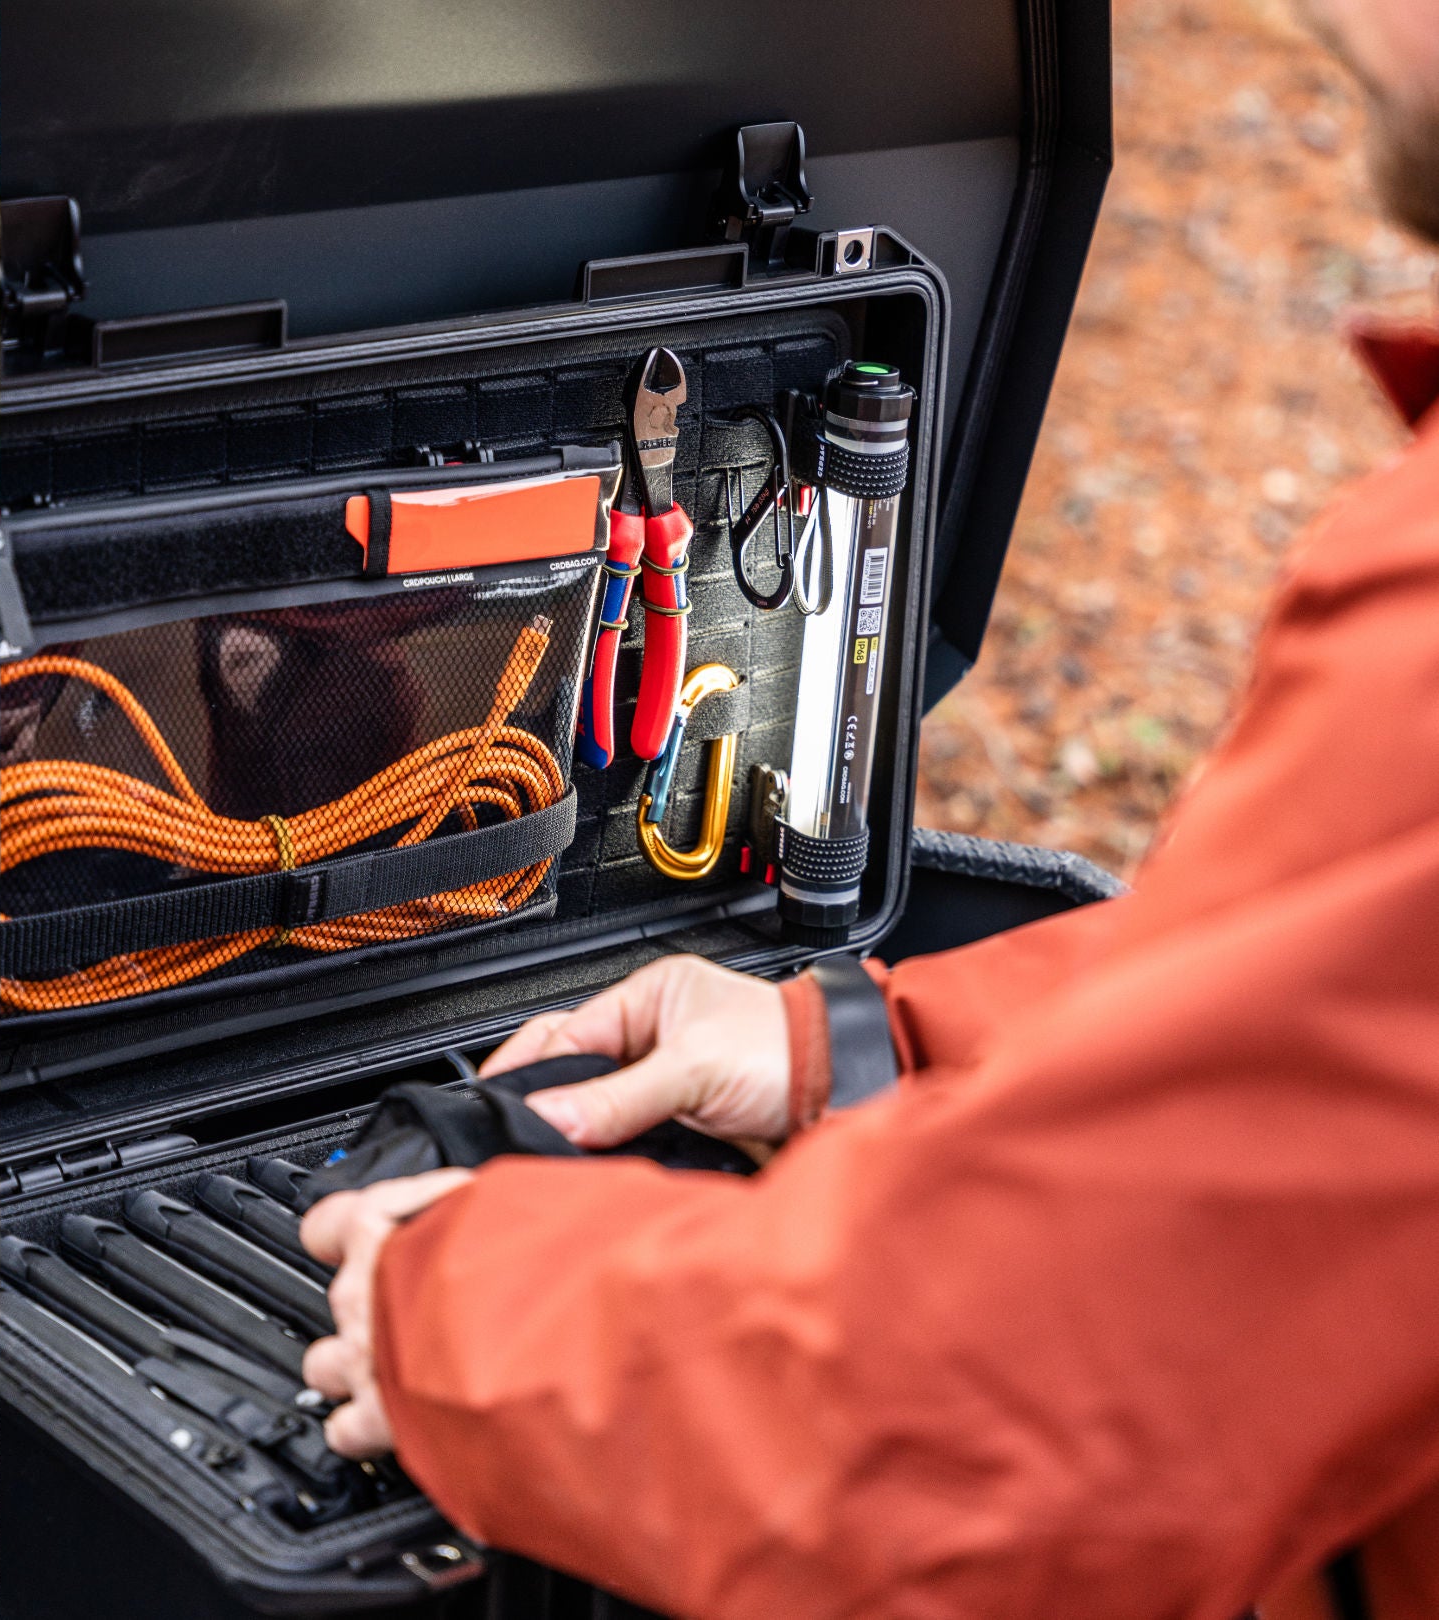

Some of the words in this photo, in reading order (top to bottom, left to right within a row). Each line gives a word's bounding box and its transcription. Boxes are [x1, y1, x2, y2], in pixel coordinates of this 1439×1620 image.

[549, 556, 598, 571] CRDBAG.COM
[451, 572, 474, 582] LARGE
[856, 640, 866, 662] IP68
